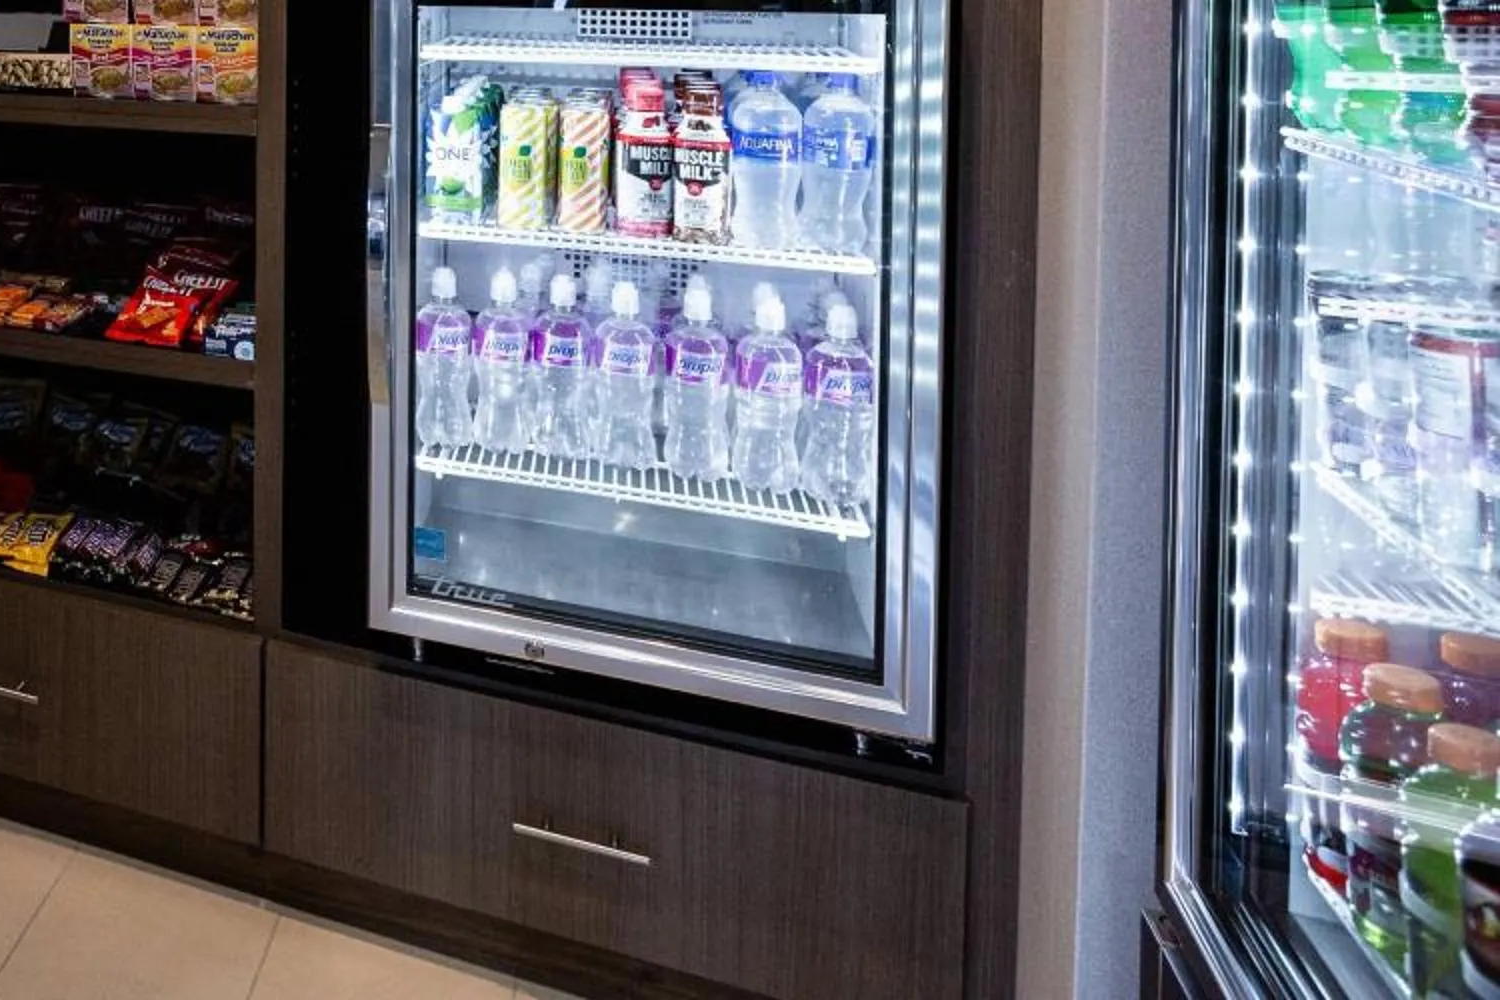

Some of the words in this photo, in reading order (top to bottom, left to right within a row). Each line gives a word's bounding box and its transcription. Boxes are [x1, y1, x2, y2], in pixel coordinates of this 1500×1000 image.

[630, 146, 670, 161] MUSC
[740, 136, 795, 155] AQUAFINA
[435, 147, 472, 161] ONE
[675, 149, 725, 165] MUSCLE
[679, 164, 714, 181] MILK
